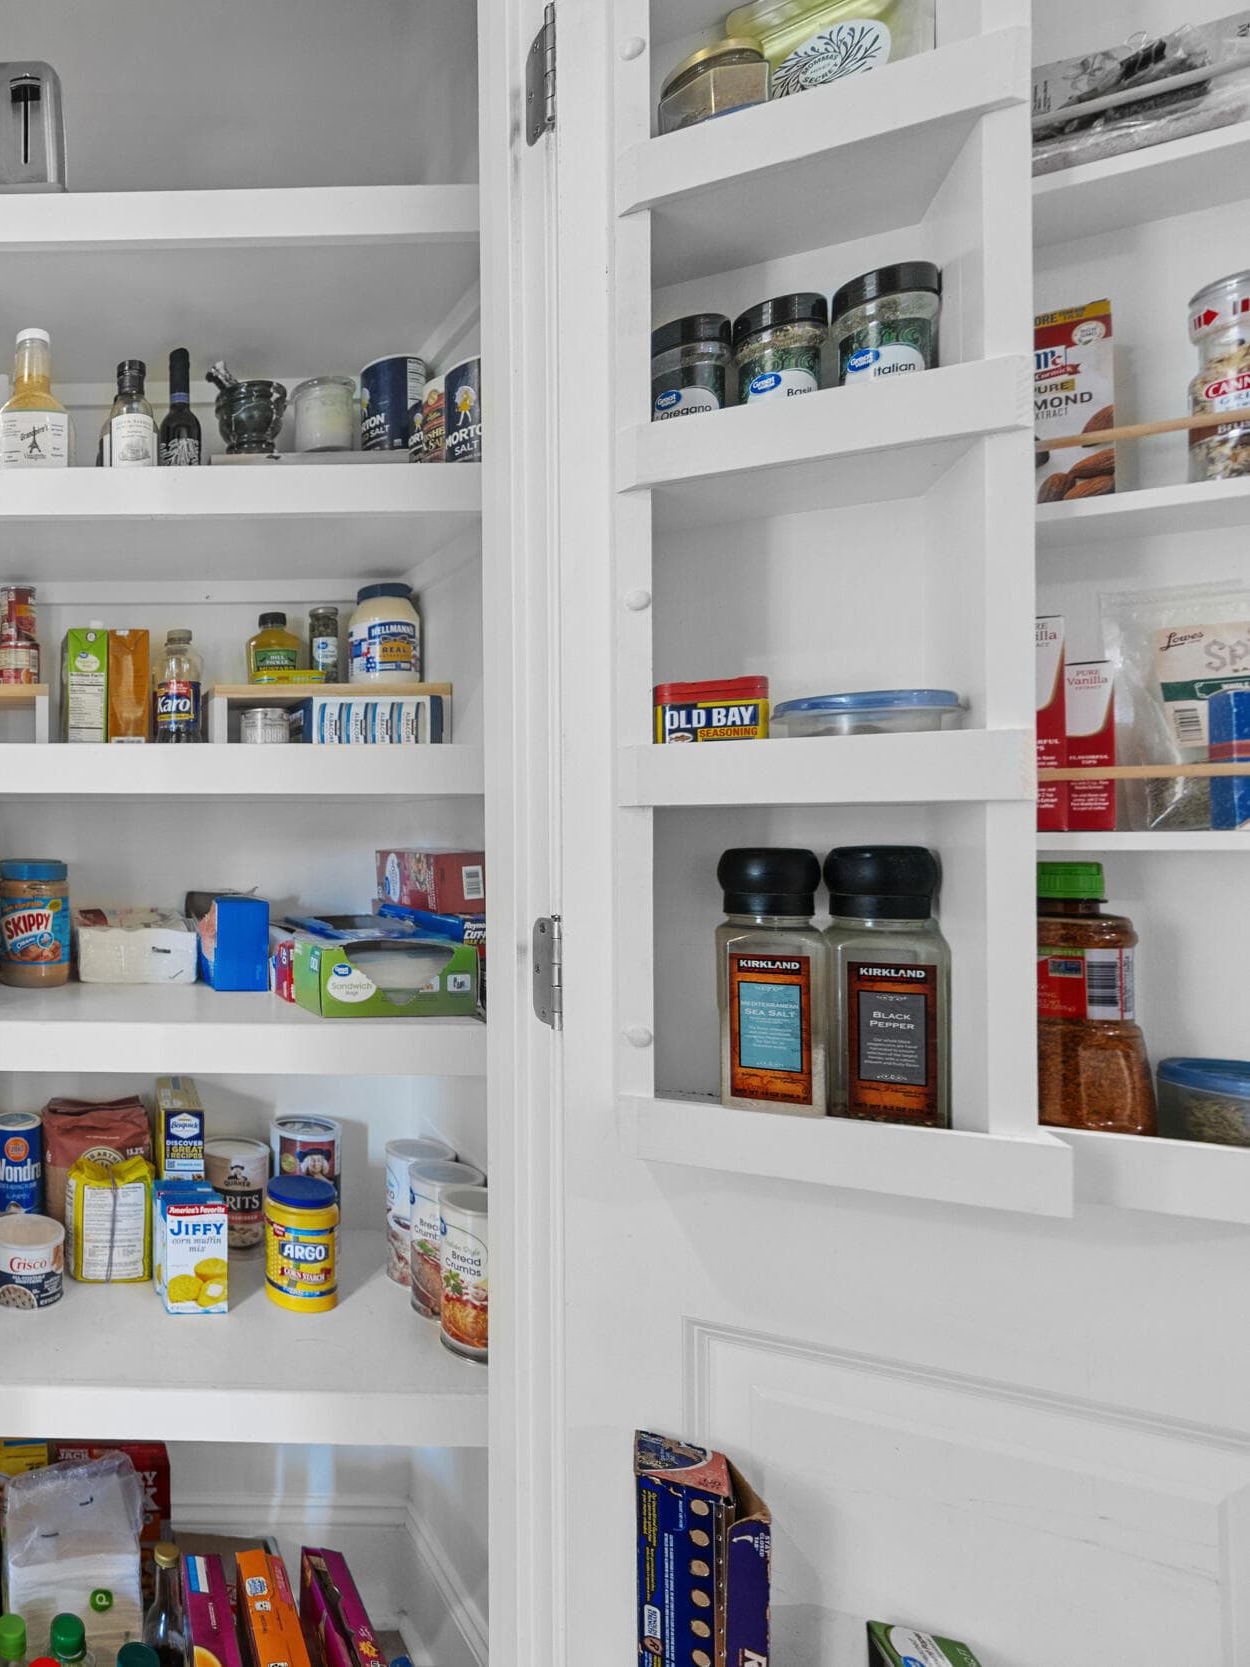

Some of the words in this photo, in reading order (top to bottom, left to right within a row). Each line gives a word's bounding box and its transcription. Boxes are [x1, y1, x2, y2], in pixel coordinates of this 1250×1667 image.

[1035, 314, 1059, 327] ORE
[873, 361, 917, 378] Italian
[1035, 366, 1073, 381] Cormick
[1034, 391, 1094, 411] MOND
[660, 404, 712, 421] Oregano
[1034, 407, 1069, 420] XTRACT
[370, 425, 391, 438] SALT
[445, 423, 482, 449] MORTO
[454, 440, 480, 456] SALT
[1035, 628, 1058, 642] illa
[381, 646, 407, 654] REAL
[1075, 669, 1100, 678] PURE
[1066, 675, 1109, 687] Vanilla
[157, 697, 191, 714] Karo
[667, 709, 710, 729] OLD
[711, 706, 752, 728] BAY
[699, 726, 759, 738] SEASONING
[4, 912, 51, 940] SKIPPY
[739, 958, 801, 970] KIRKLAND
[859, 967, 926, 979] KIRKLAND
[331, 982, 373, 991] Sandwich
[740, 1000, 799, 1010] MEDITERRANEAN
[223, 1180, 251, 1188] QUAKER
[225, 1195, 260, 1209] RITS
[169, 1206, 199, 1215] America's
[199, 1206, 226, 1214] Favorite
[193, 1236, 223, 1245] muffin
[188, 1245, 206, 1253] mix
[282, 1243, 327, 1261] ARGO
[9, 1256, 47, 1272] Crisco
[451, 1249, 482, 1268] Bread
[283, 1266, 302, 1278] CORN
[302, 1270, 327, 1282] STARCH
[444, 1256, 483, 1278] Crumbs
